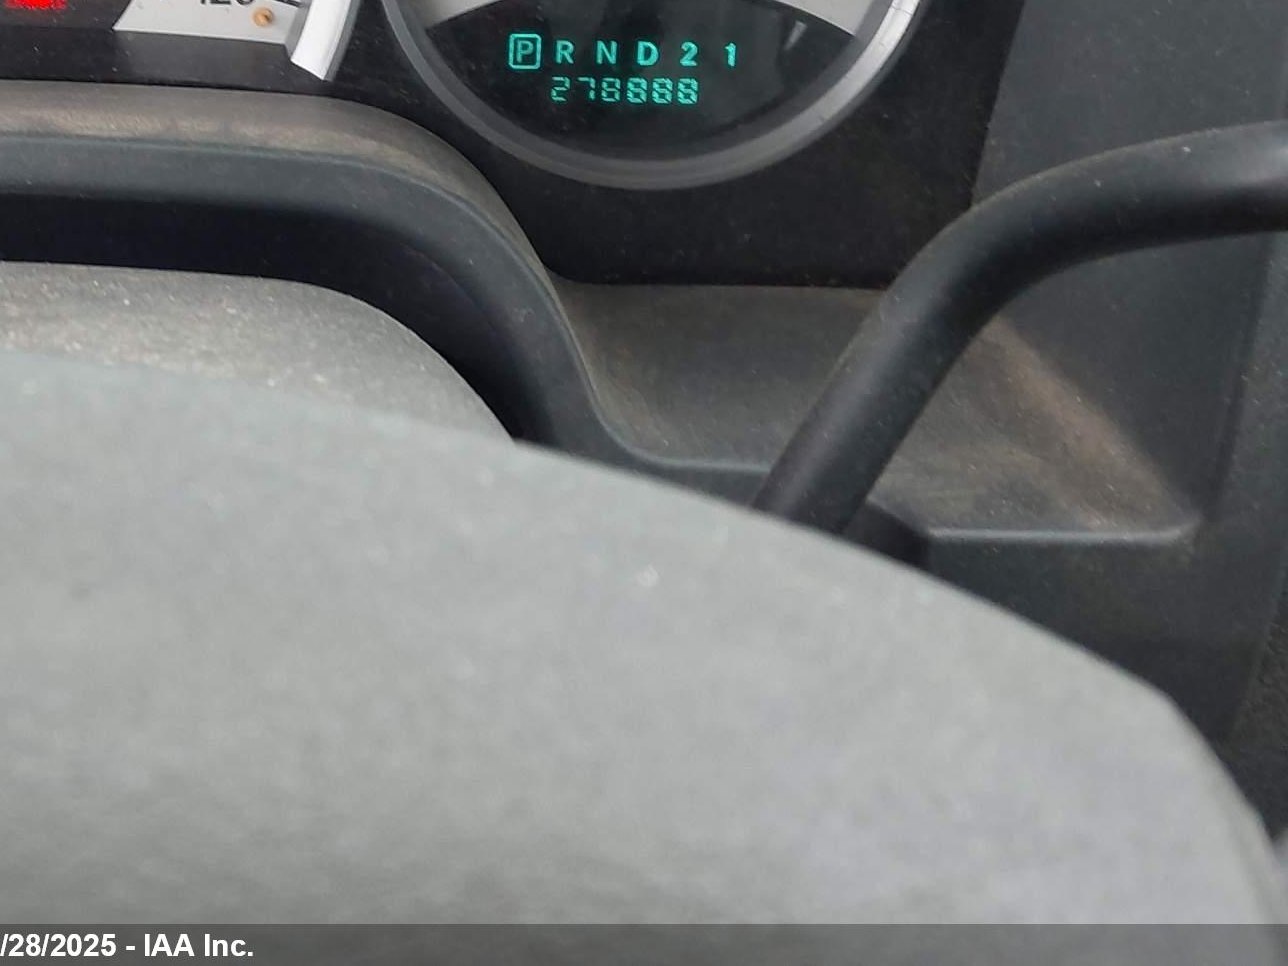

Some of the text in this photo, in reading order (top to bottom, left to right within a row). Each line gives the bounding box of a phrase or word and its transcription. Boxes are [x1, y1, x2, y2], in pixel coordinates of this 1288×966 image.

[517, 40, 736, 66] P R N D 2 1
